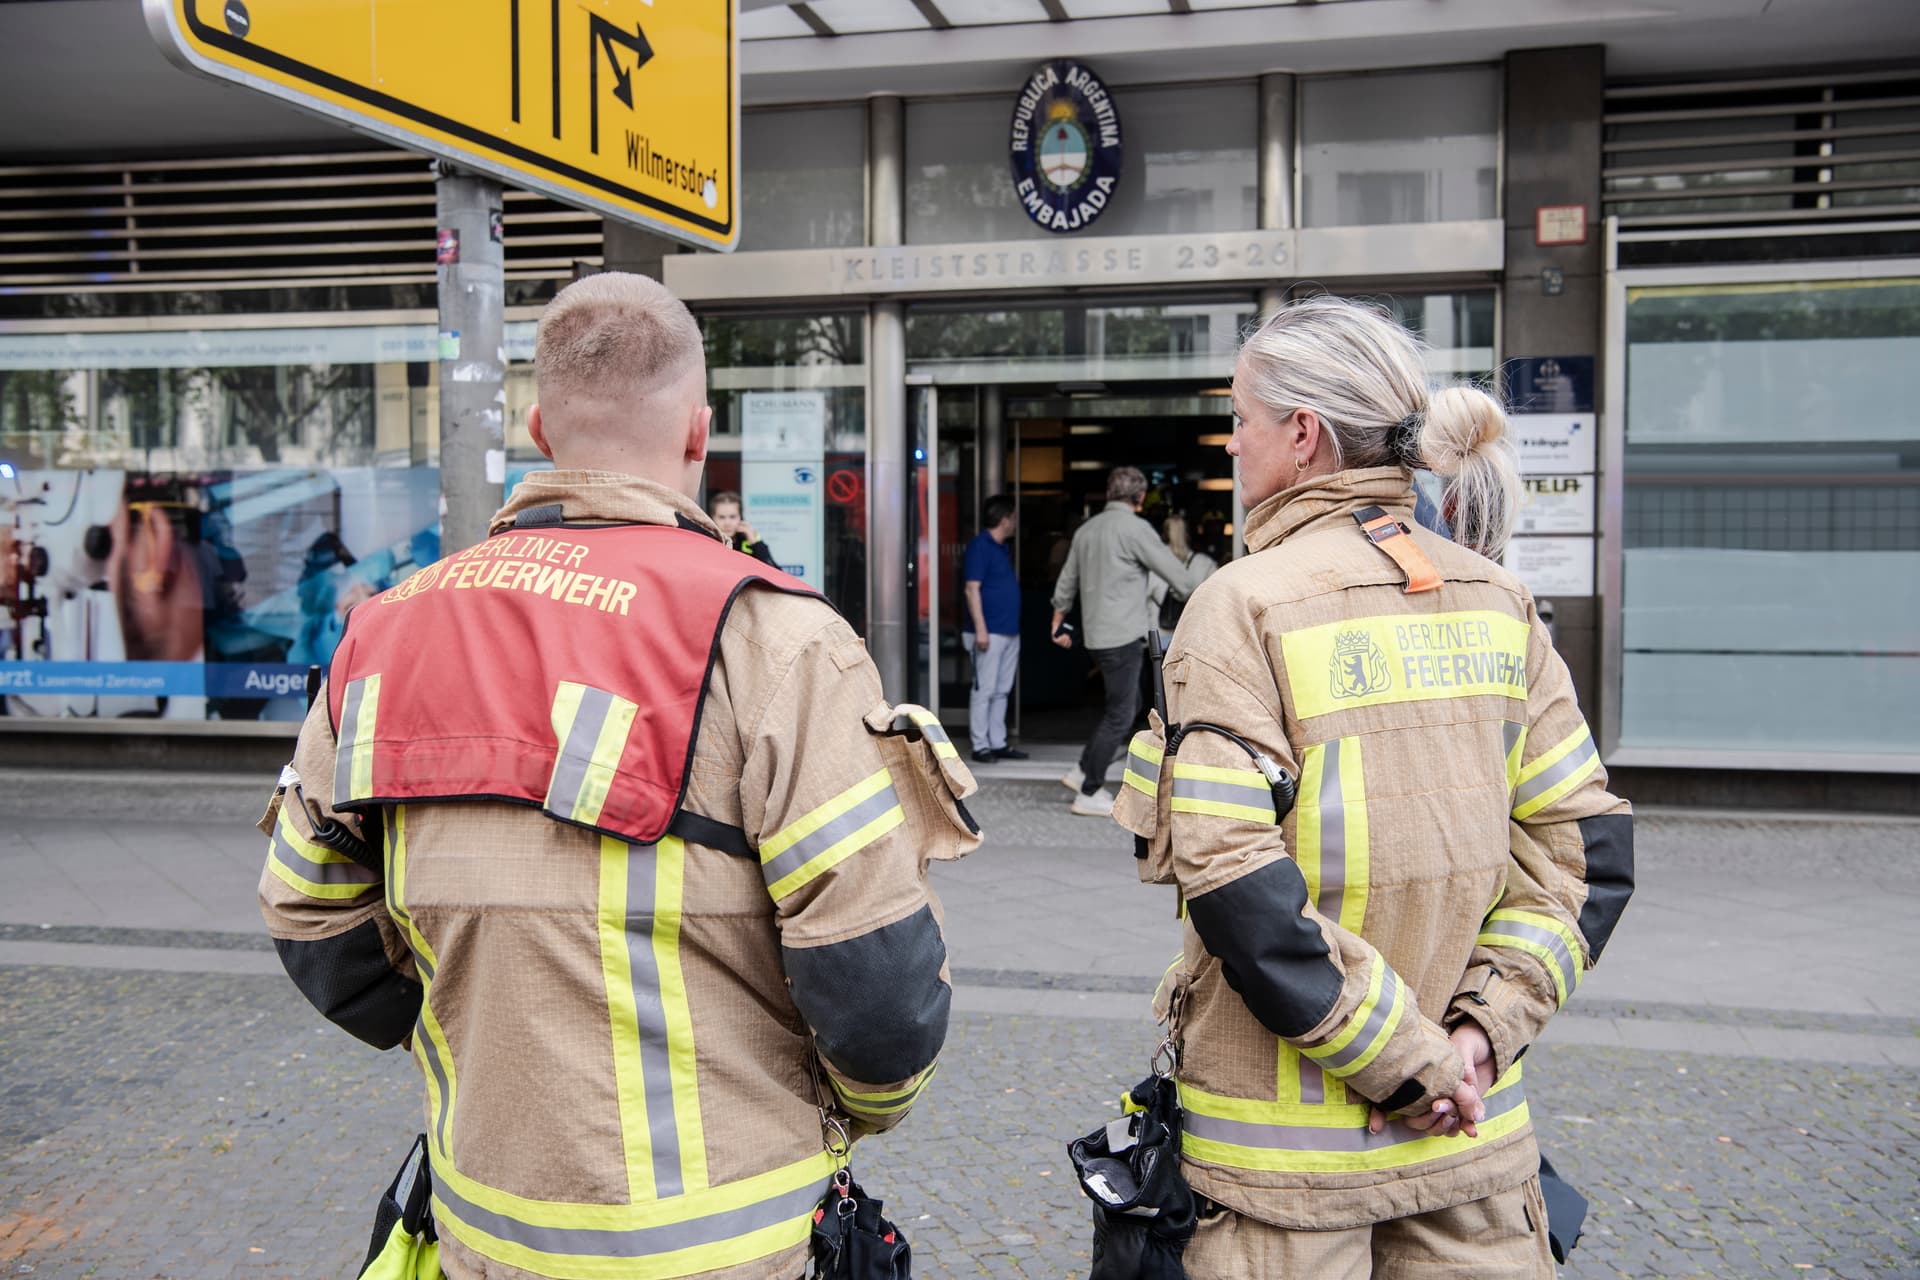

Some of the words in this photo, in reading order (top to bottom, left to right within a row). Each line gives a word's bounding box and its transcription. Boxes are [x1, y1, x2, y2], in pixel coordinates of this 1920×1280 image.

[1012, 67, 1060, 151] REPUBLICA
[1065, 66, 1119, 148] ARGENTINA
[626, 128, 717, 198] Wilmersdof
[1018, 176, 1115, 230] EMBAJADA
[846, 247, 1142, 281] KLEISTSTRASSE
[1177, 242, 1289, 269] 23-26
[458, 536, 589, 568] BERLINER
[439, 560, 638, 616] FEUERWEHR
[1395, 620, 1492, 651] BERLINER
[106, 674, 165, 688] Zentrum
